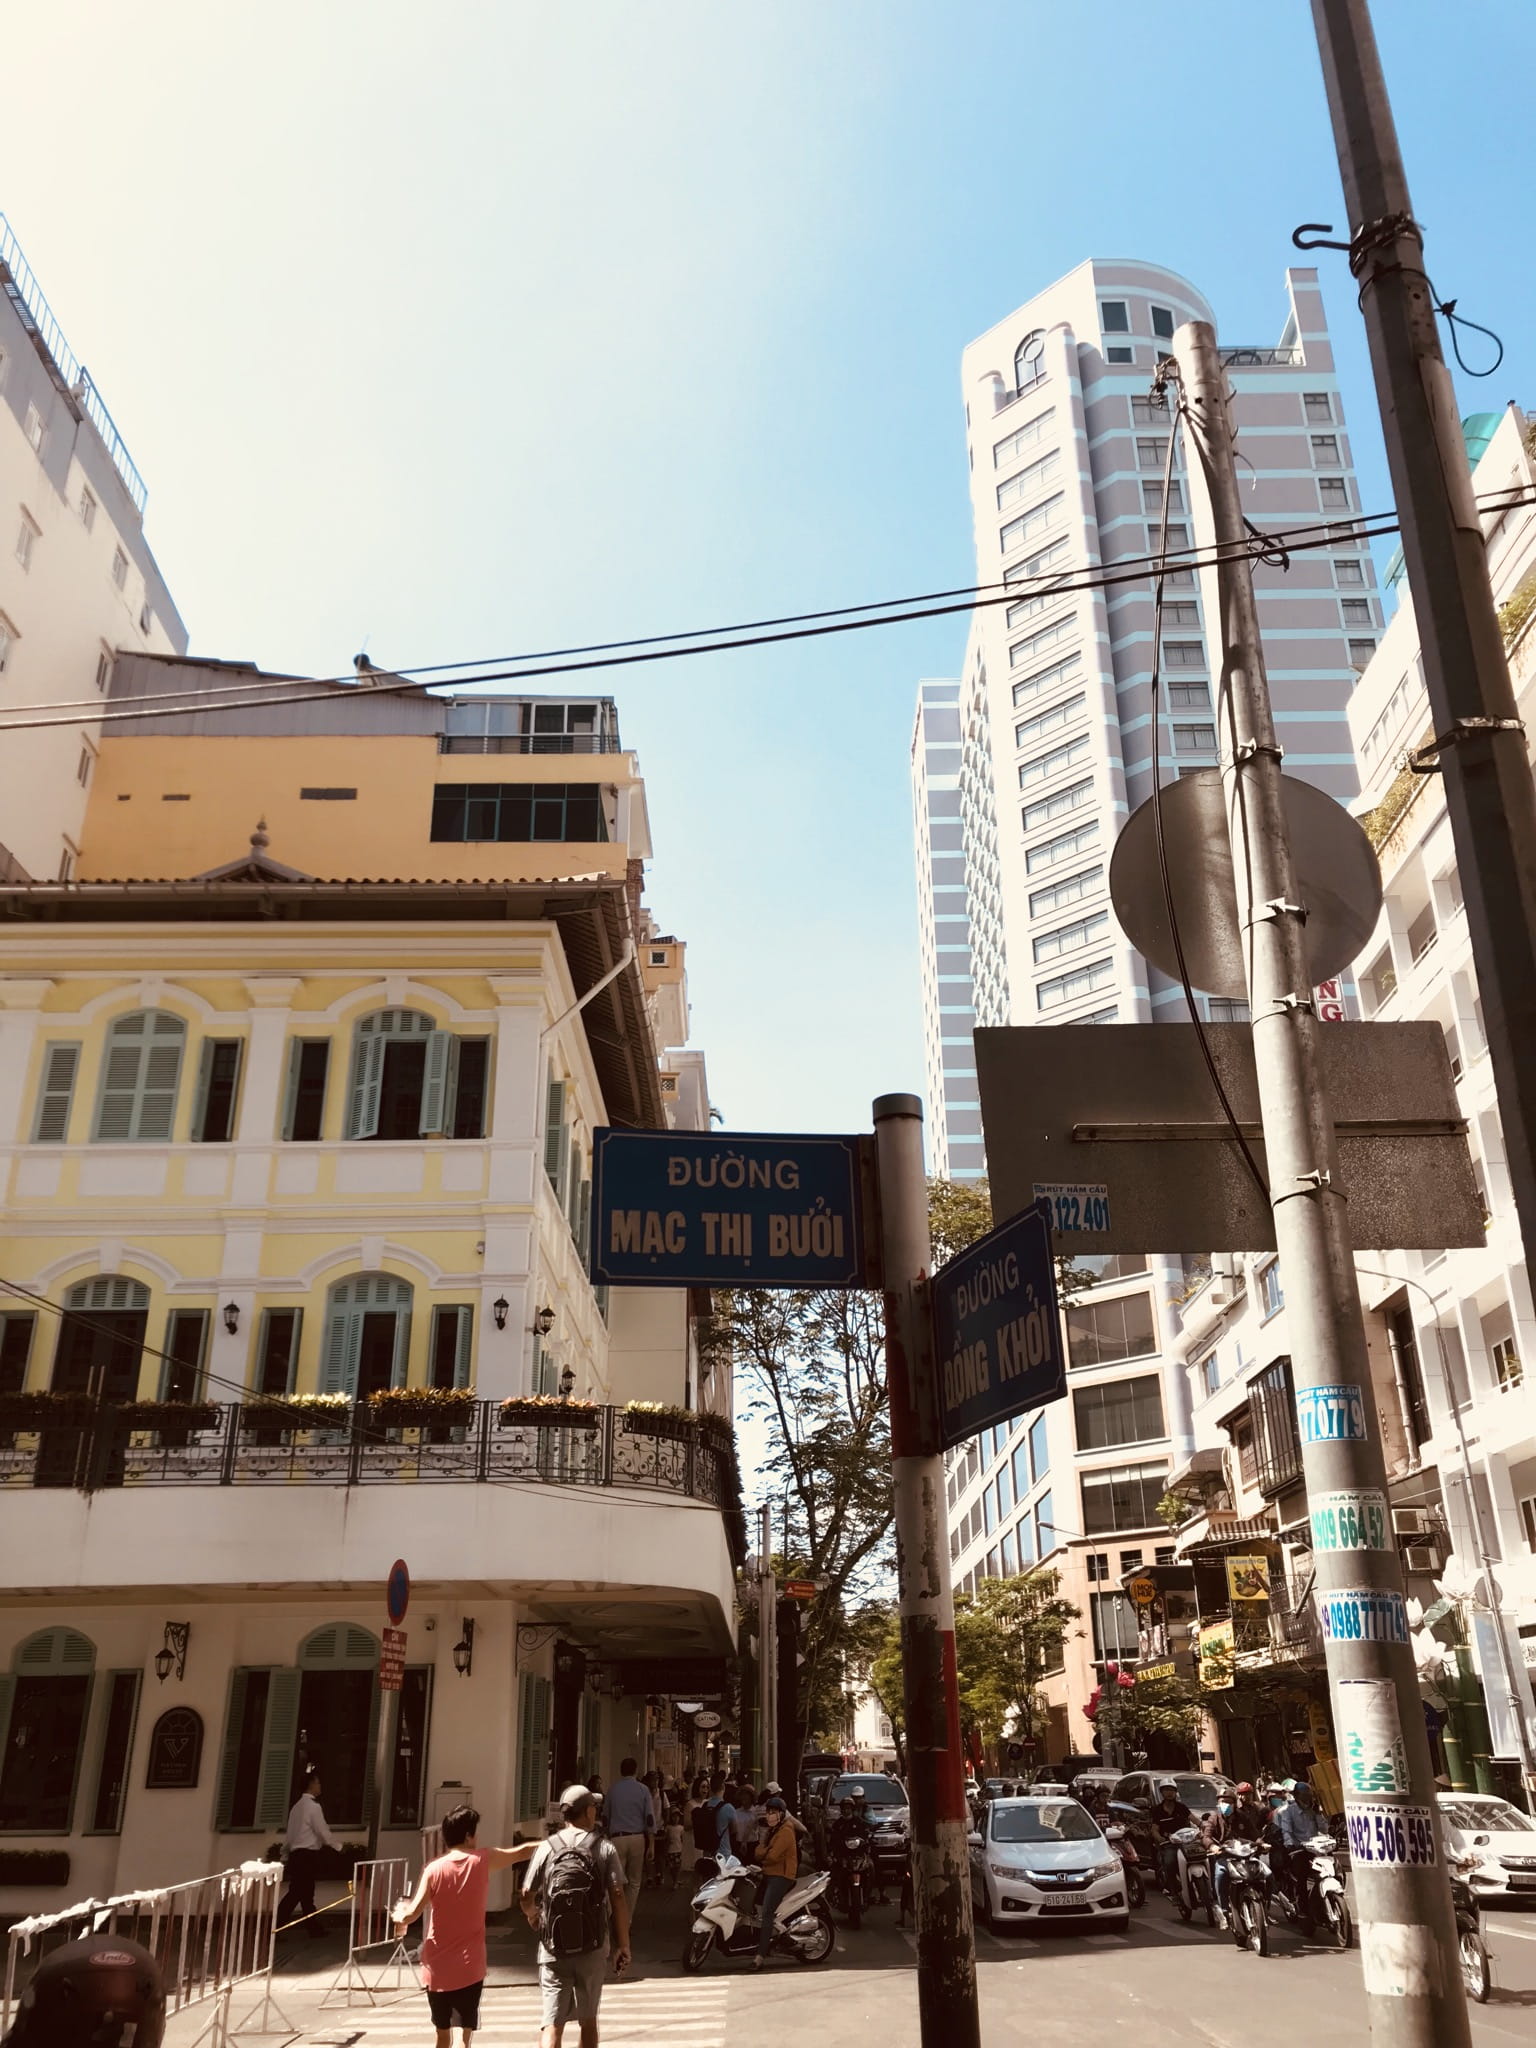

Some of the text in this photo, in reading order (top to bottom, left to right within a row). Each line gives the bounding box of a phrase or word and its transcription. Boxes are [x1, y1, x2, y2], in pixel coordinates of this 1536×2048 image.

[667, 1151, 800, 1190] ĐƯỜNG
[610, 1196, 844, 1266] MẠC THỊ BƯỞI
[956, 1251, 1020, 1320] ĐƯỜNG
[944, 1283, 1051, 1412] ĐỒNG KHỞI
